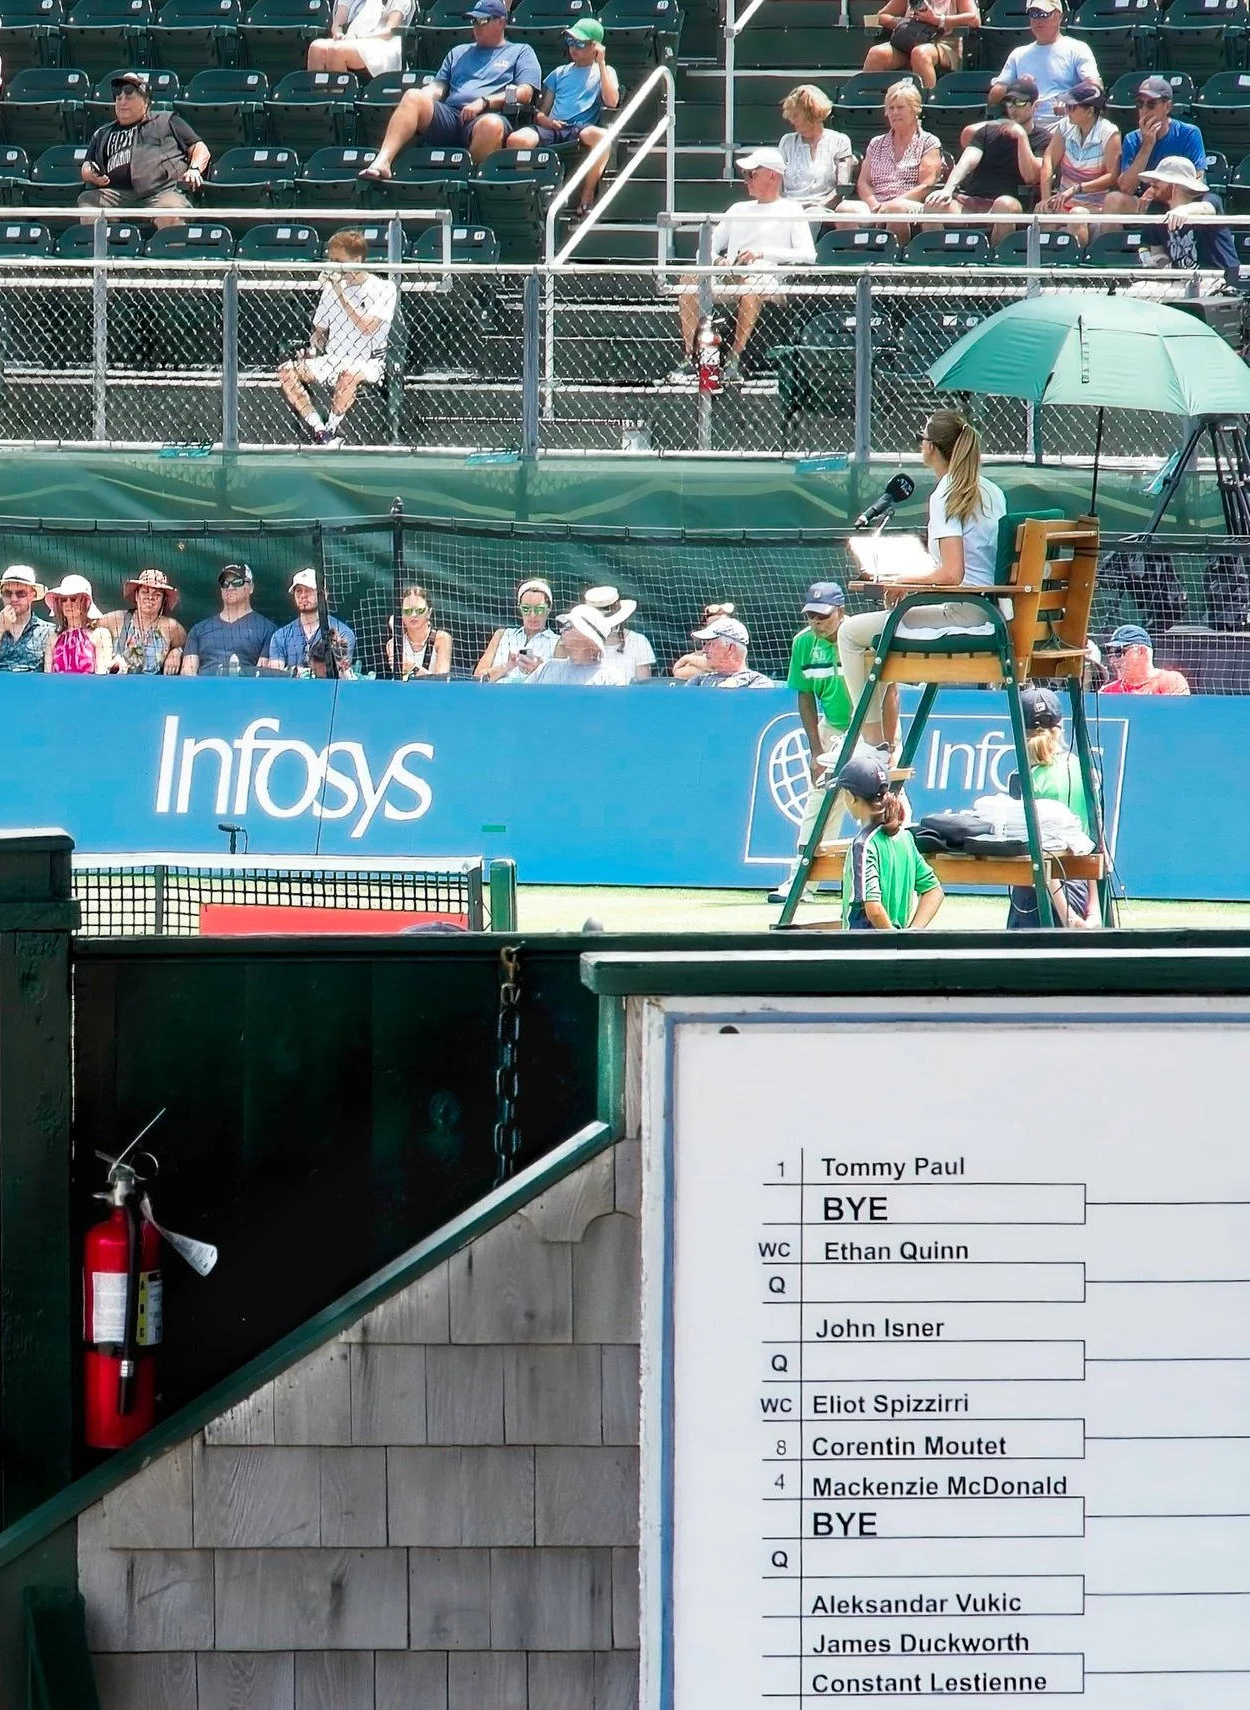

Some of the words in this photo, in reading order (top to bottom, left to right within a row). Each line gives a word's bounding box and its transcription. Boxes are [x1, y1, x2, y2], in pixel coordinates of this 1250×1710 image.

[155, 715, 435, 838] Infosys
[777, 1161, 785, 1178] 1
[821, 1157, 906, 1181] Tommy
[915, 1156, 965, 1176] Paul
[823, 1196, 888, 1222] BYE
[758, 1242, 791, 1258] WC
[825, 1241, 891, 1261] Ethan
[899, 1240, 969, 1261] Quinn
[768, 1275, 786, 1294] Q
[815, 1318, 875, 1339] John
[885, 1318, 945, 1338] Isner
[771, 1354, 788, 1373] Q
[760, 1397, 792, 1414] WC
[813, 1395, 866, 1414] Eliot
[873, 1393, 969, 1418] Spizzirri
[776, 1439, 787, 1456] 8
[812, 1436, 915, 1457] Corentin
[925, 1435, 1007, 1456] Moutet
[774, 1473, 785, 1490] 4
[813, 1476, 939, 1497] Mackenzie
[947, 1475, 1067, 1496] McDonald
[813, 1512, 878, 1537] BYE
[771, 1550, 788, 1569] Q
[811, 1593, 949, 1615] Aleksandar
[955, 1592, 1021, 1613] Vukic
[812, 1634, 891, 1654] James
[900, 1632, 1029, 1653] Duckworth
[812, 1673, 922, 1693] Constant
[930, 1672, 1047, 1692] Lestienne
